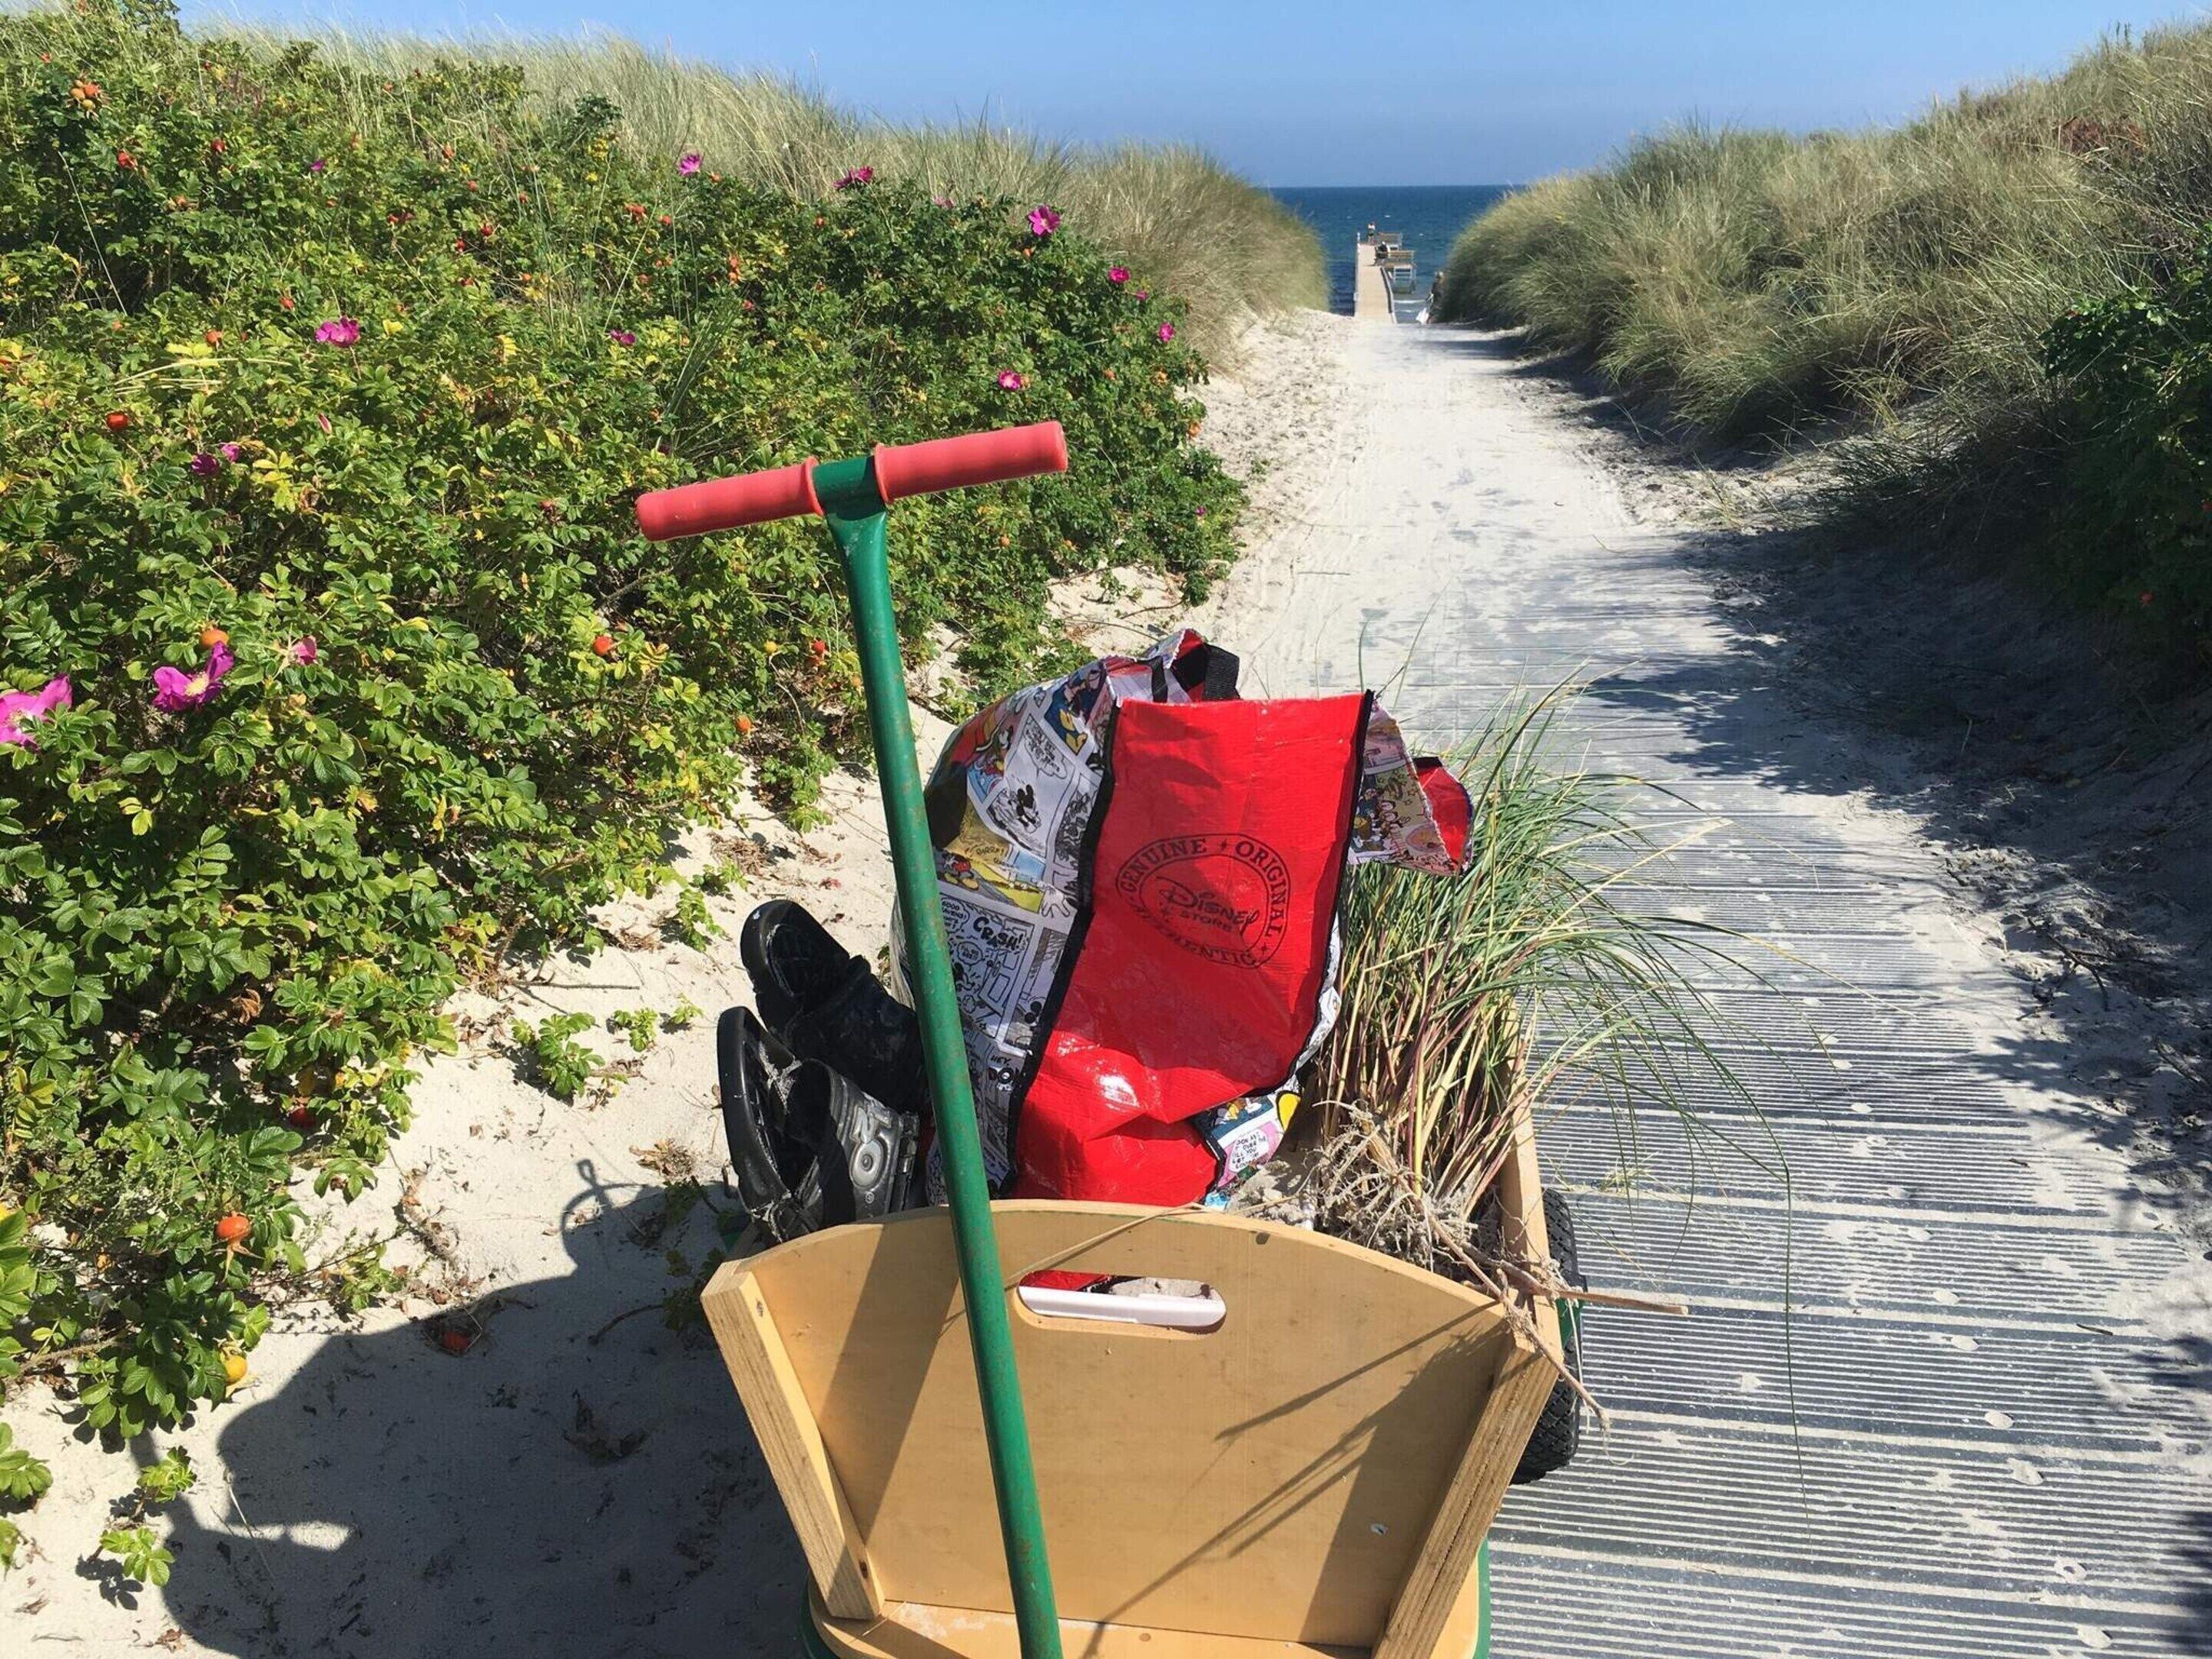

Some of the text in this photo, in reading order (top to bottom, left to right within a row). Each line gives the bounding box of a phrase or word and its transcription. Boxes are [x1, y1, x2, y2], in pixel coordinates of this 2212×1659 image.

[1119, 837, 1288, 938] GENUINE ORIGINAL
[973, 916, 1025, 951] CRASH!
[1179, 910, 1233, 932] STORE
